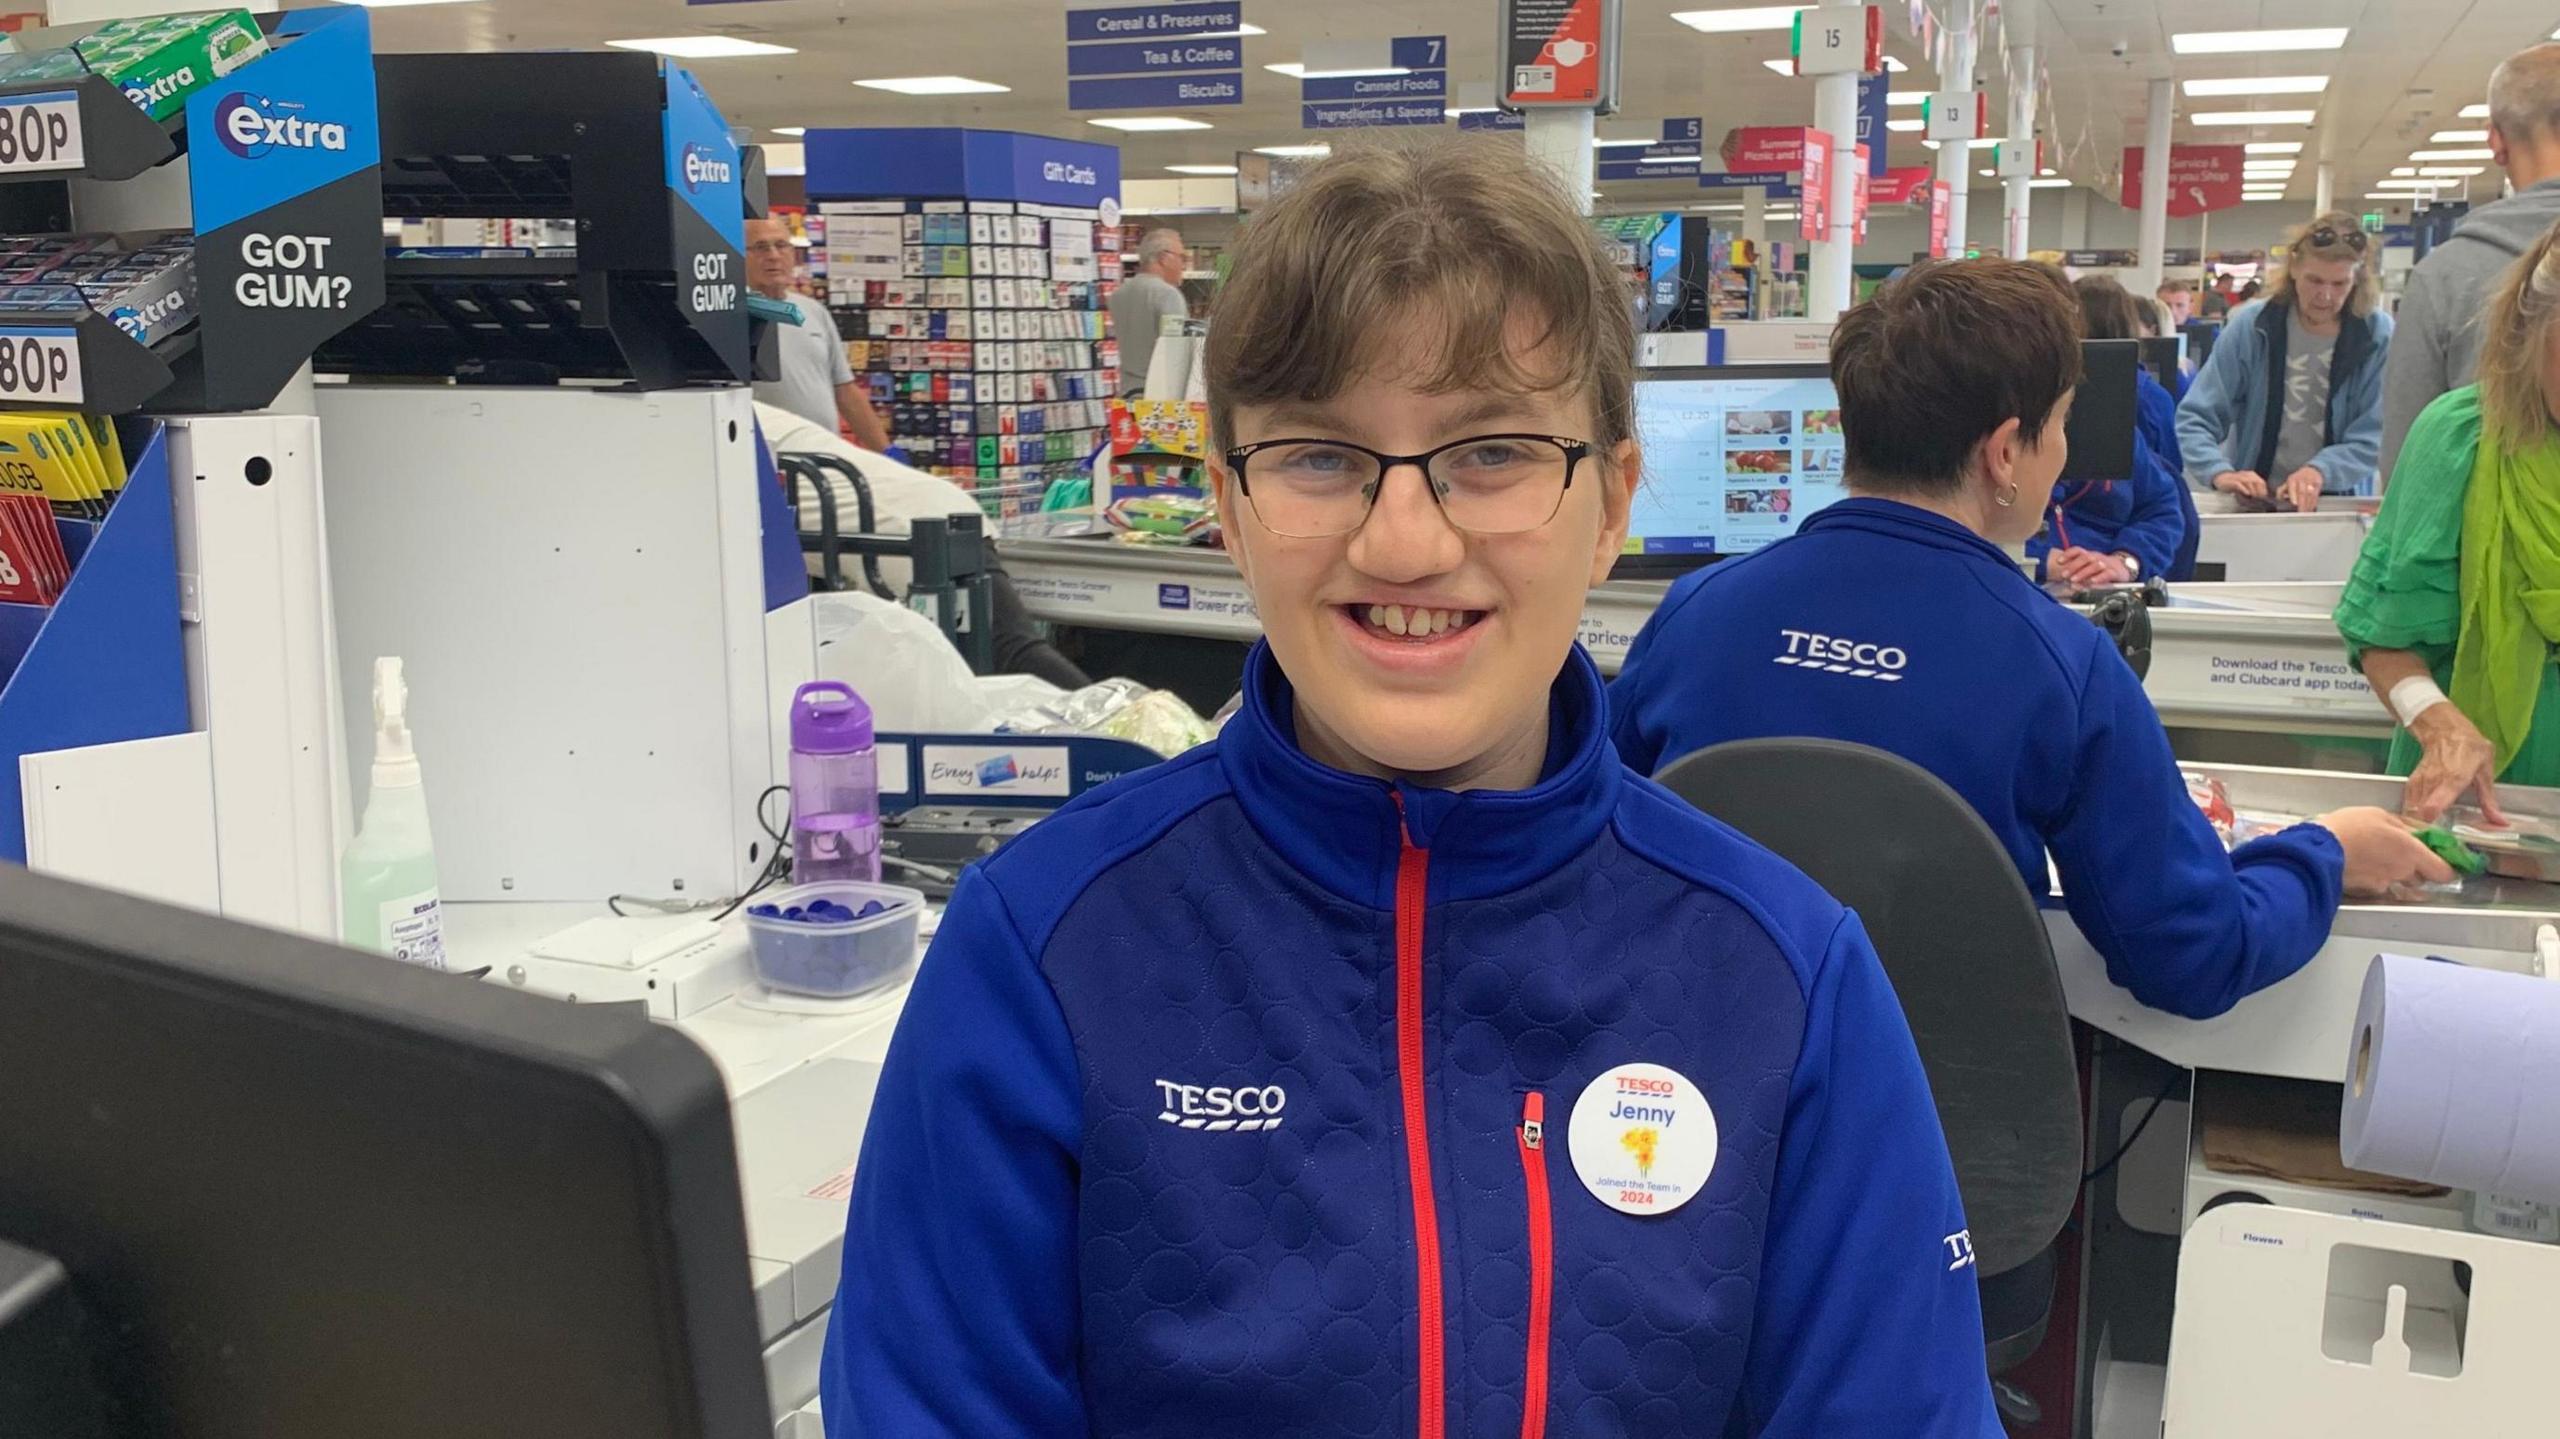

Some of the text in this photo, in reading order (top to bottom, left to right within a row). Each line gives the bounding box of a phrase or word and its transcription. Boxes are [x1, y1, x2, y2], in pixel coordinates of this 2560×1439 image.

[1096, 12, 1233, 31] Cereal & Preserves
[1825, 29, 1840, 47] 15
[1143, 47, 1233, 64] Tea & Coffee
[1427, 41, 1441, 63] 7
[1179, 82, 1235, 98] Biscuits
[1354, 78, 1440, 93] Canned Foods
[1317, 106, 1439, 123] Ingredients & Sauces
[1947, 108, 1959, 121] 13
[0, 105, 68, 164] 80p
[228, 105, 346, 151] extra
[1687, 121, 1698, 136] 5
[686, 153, 730, 183] extra
[1043, 161, 1096, 186] Gift Cards
[242, 233, 331, 269] GOT
[693, 253, 727, 281] GOT
[235, 273, 352, 309] GUM?
[692, 284, 736, 312] GUM?
[0, 337, 68, 393] 80p
[1194, 597, 1228, 612] lower
[1781, 629, 1907, 670] TESCO
[2212, 656, 2347, 675] Download the Tesco
[2210, 672, 2371, 692] and Clubcard app today
[931, 762, 1061, 785] Every helps
[1085, 770, 1113, 782] Don't
[1617, 1077, 1674, 1093] TESCO
[1156, 1079, 1286, 1116] TESCO
[1610, 1101, 1675, 1127] Jenny
[1596, 1177, 1681, 1192] Joined the Team in
[1620, 1191, 1654, 1204] 2024
[2243, 1233, 2283, 1245] Flowers
